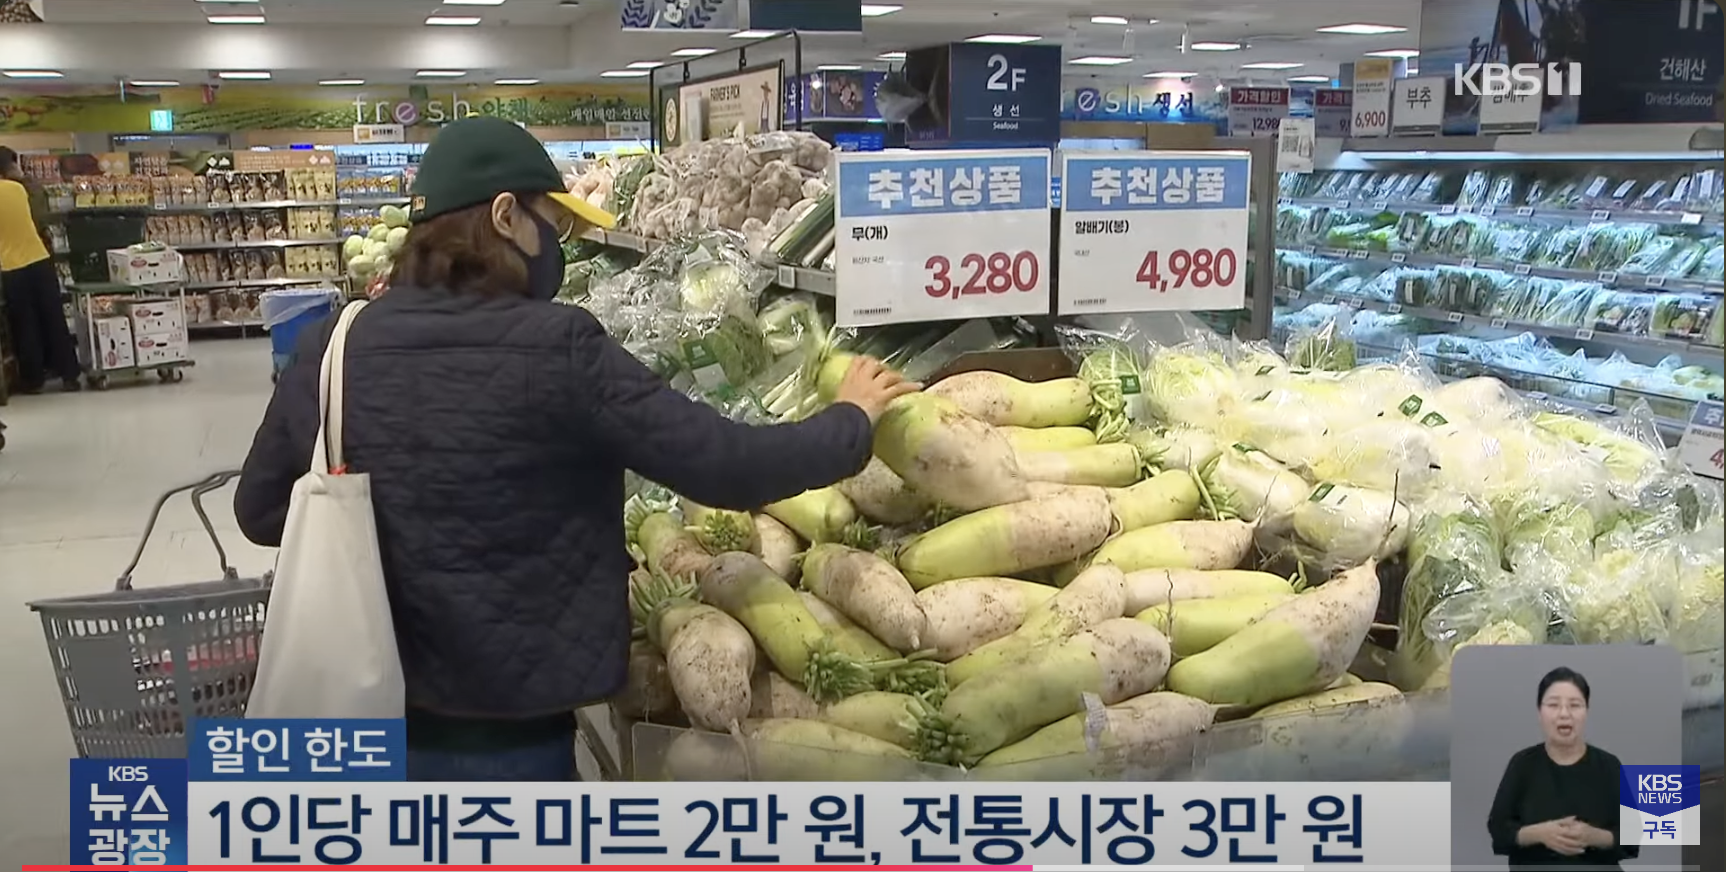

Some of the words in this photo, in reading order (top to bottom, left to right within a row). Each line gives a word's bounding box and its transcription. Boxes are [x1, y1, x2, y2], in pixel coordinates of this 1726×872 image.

[986, 53, 1027, 92] 2F
[1659, 56, 1707, 82] 건해산
[352, 91, 471, 123] fresh
[1060, 84, 1143, 114] resh
[1406, 86, 1432, 109] 부추
[1645, 91, 1672, 106] Dried
[1673, 91, 1714, 107] Seafood
[993, 121, 1019, 130] Seafood
[1355, 111, 1386, 129] 6,900
[868, 165, 1022, 210] 추천상품
[1091, 166, 1225, 206] 추천상품
[852, 225, 889, 242] 무(개)
[924, 250, 1039, 300] 3,280
[1136, 247, 1237, 293] 4,980
